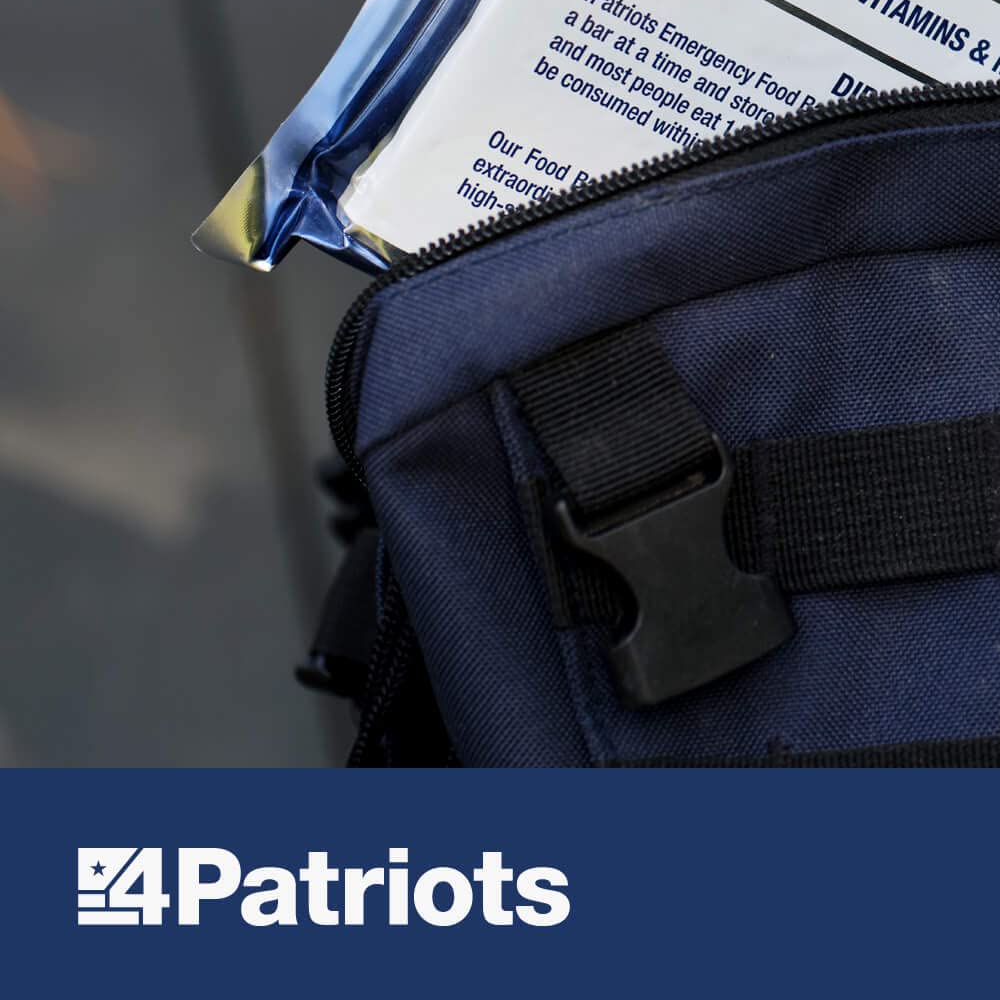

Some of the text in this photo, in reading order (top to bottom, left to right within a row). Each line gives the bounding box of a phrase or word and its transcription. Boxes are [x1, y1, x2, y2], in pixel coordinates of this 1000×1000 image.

[549, 35, 588, 62] and
[584, 52, 633, 86] most
[627, 75, 691, 114] people
[690, 106, 723, 131] eat
[564, 10, 579, 27] a
[580, 15, 615, 43] bar
[613, 35, 636, 56] at
[635, 46, 650, 63] a
[651, 51, 692, 84] time
[693, 76, 731, 103] and
[658, 22, 757, 87] Emergency
[754, 72, 801, 107] Food
[968, 39, 991, 66] &
[533, 56, 560, 81] be
[560, 73, 654, 127] consumed
[472, 158, 554, 202] extraordi
[488, 130, 523, 158] Our
[524, 148, 572, 182] Food
